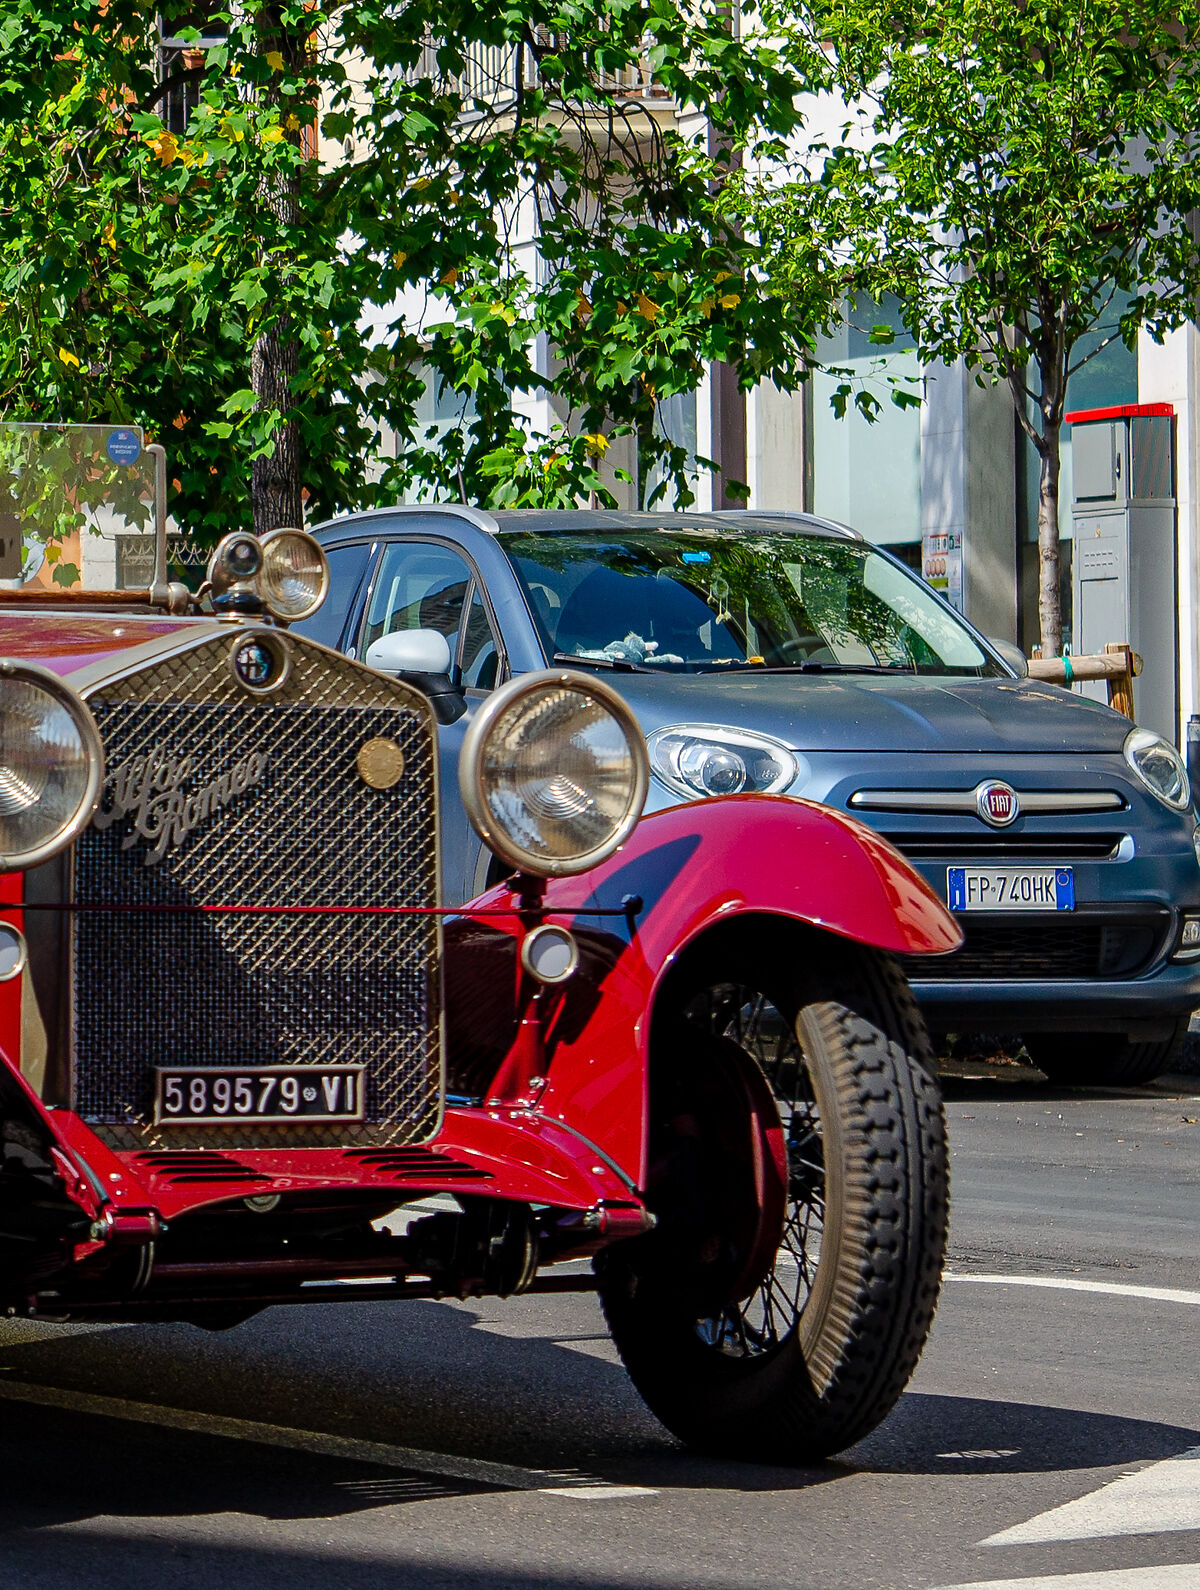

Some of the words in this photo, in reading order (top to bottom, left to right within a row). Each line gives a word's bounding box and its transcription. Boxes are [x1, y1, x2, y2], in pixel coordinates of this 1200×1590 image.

[94, 744, 193, 849] Alfa
[140, 751, 268, 866] Romeo
[989, 794, 1010, 813] FIAT
[165, 1077, 299, 1114] 589579
[321, 1075, 354, 1112] VI
